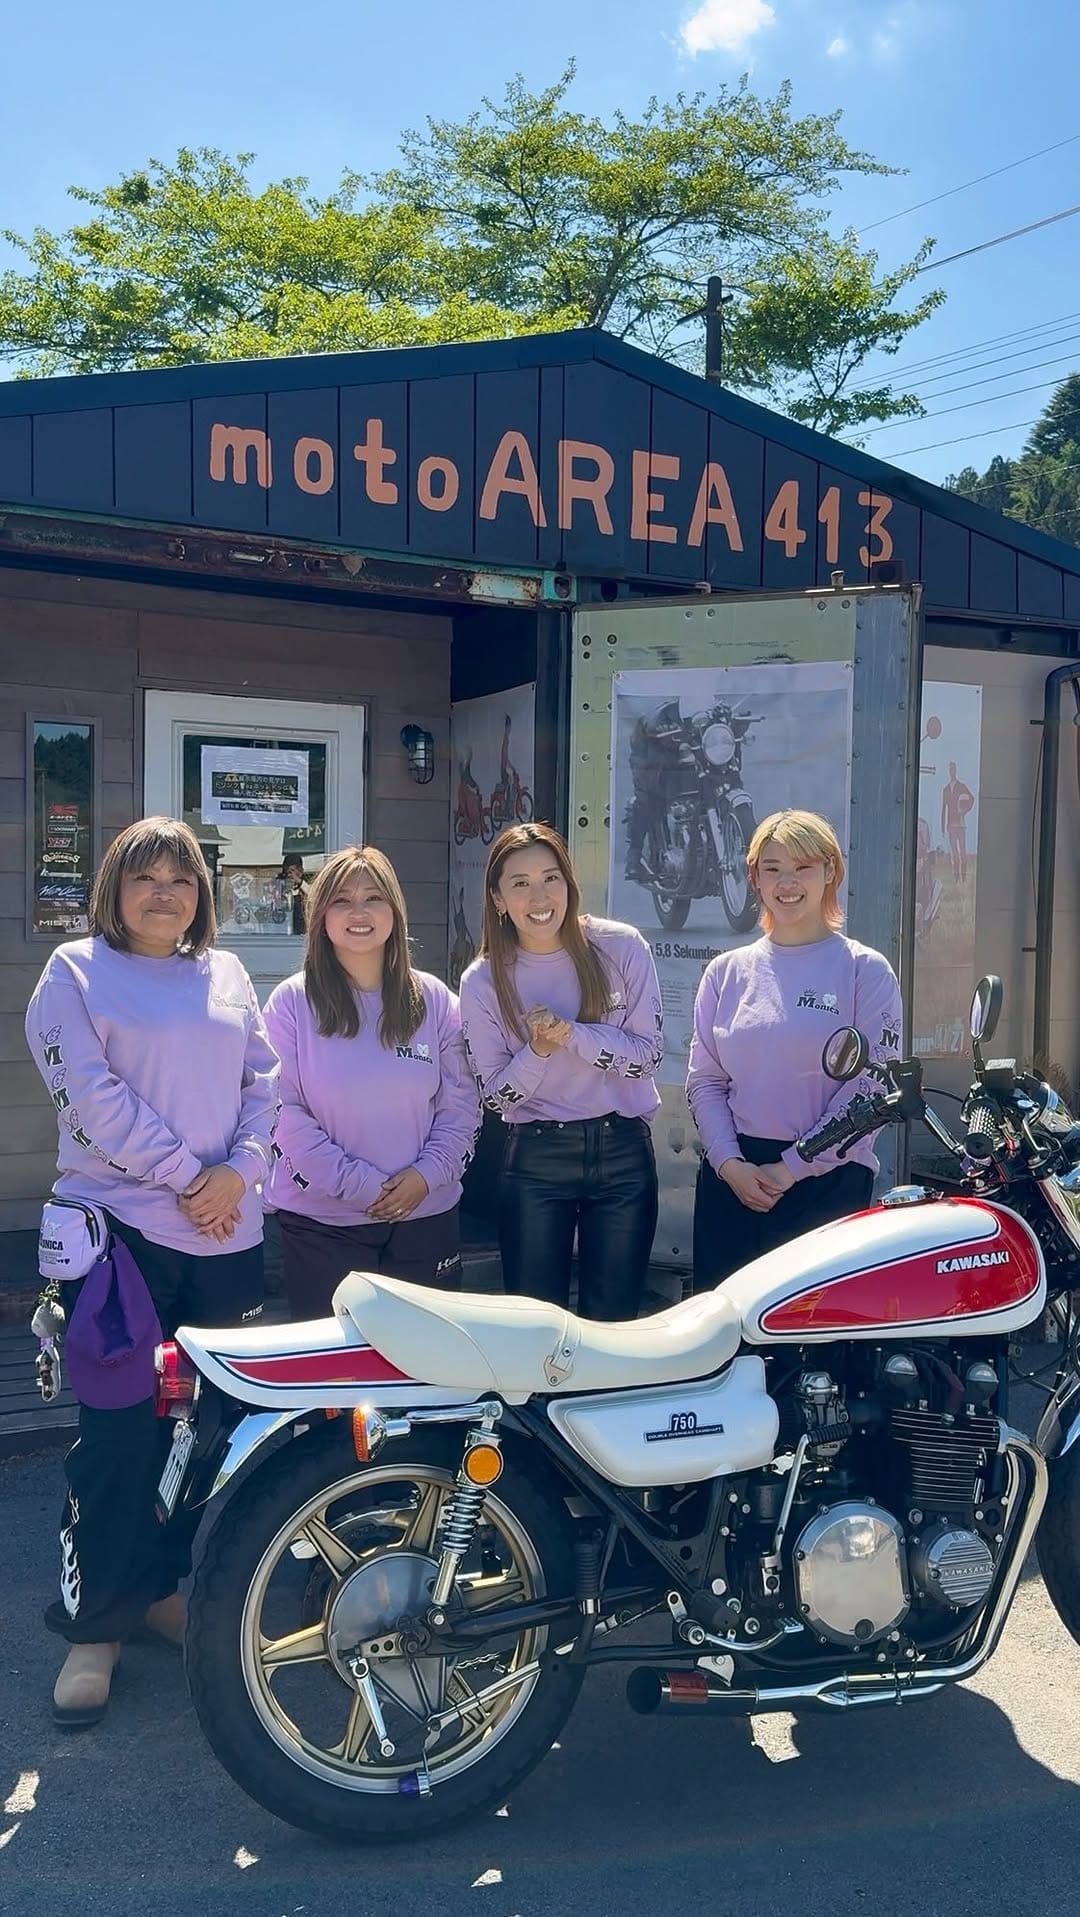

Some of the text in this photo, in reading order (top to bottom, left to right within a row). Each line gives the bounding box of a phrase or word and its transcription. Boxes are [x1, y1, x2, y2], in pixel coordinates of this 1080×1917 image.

[655, 943, 672, 959] 5,8
[797, 996, 840, 1015] Monica
[937, 1251, 1010, 1274] KAWASAKI
[672, 1415, 695, 1431] 750
[944, 1565, 989, 1577] KAWASAKI
